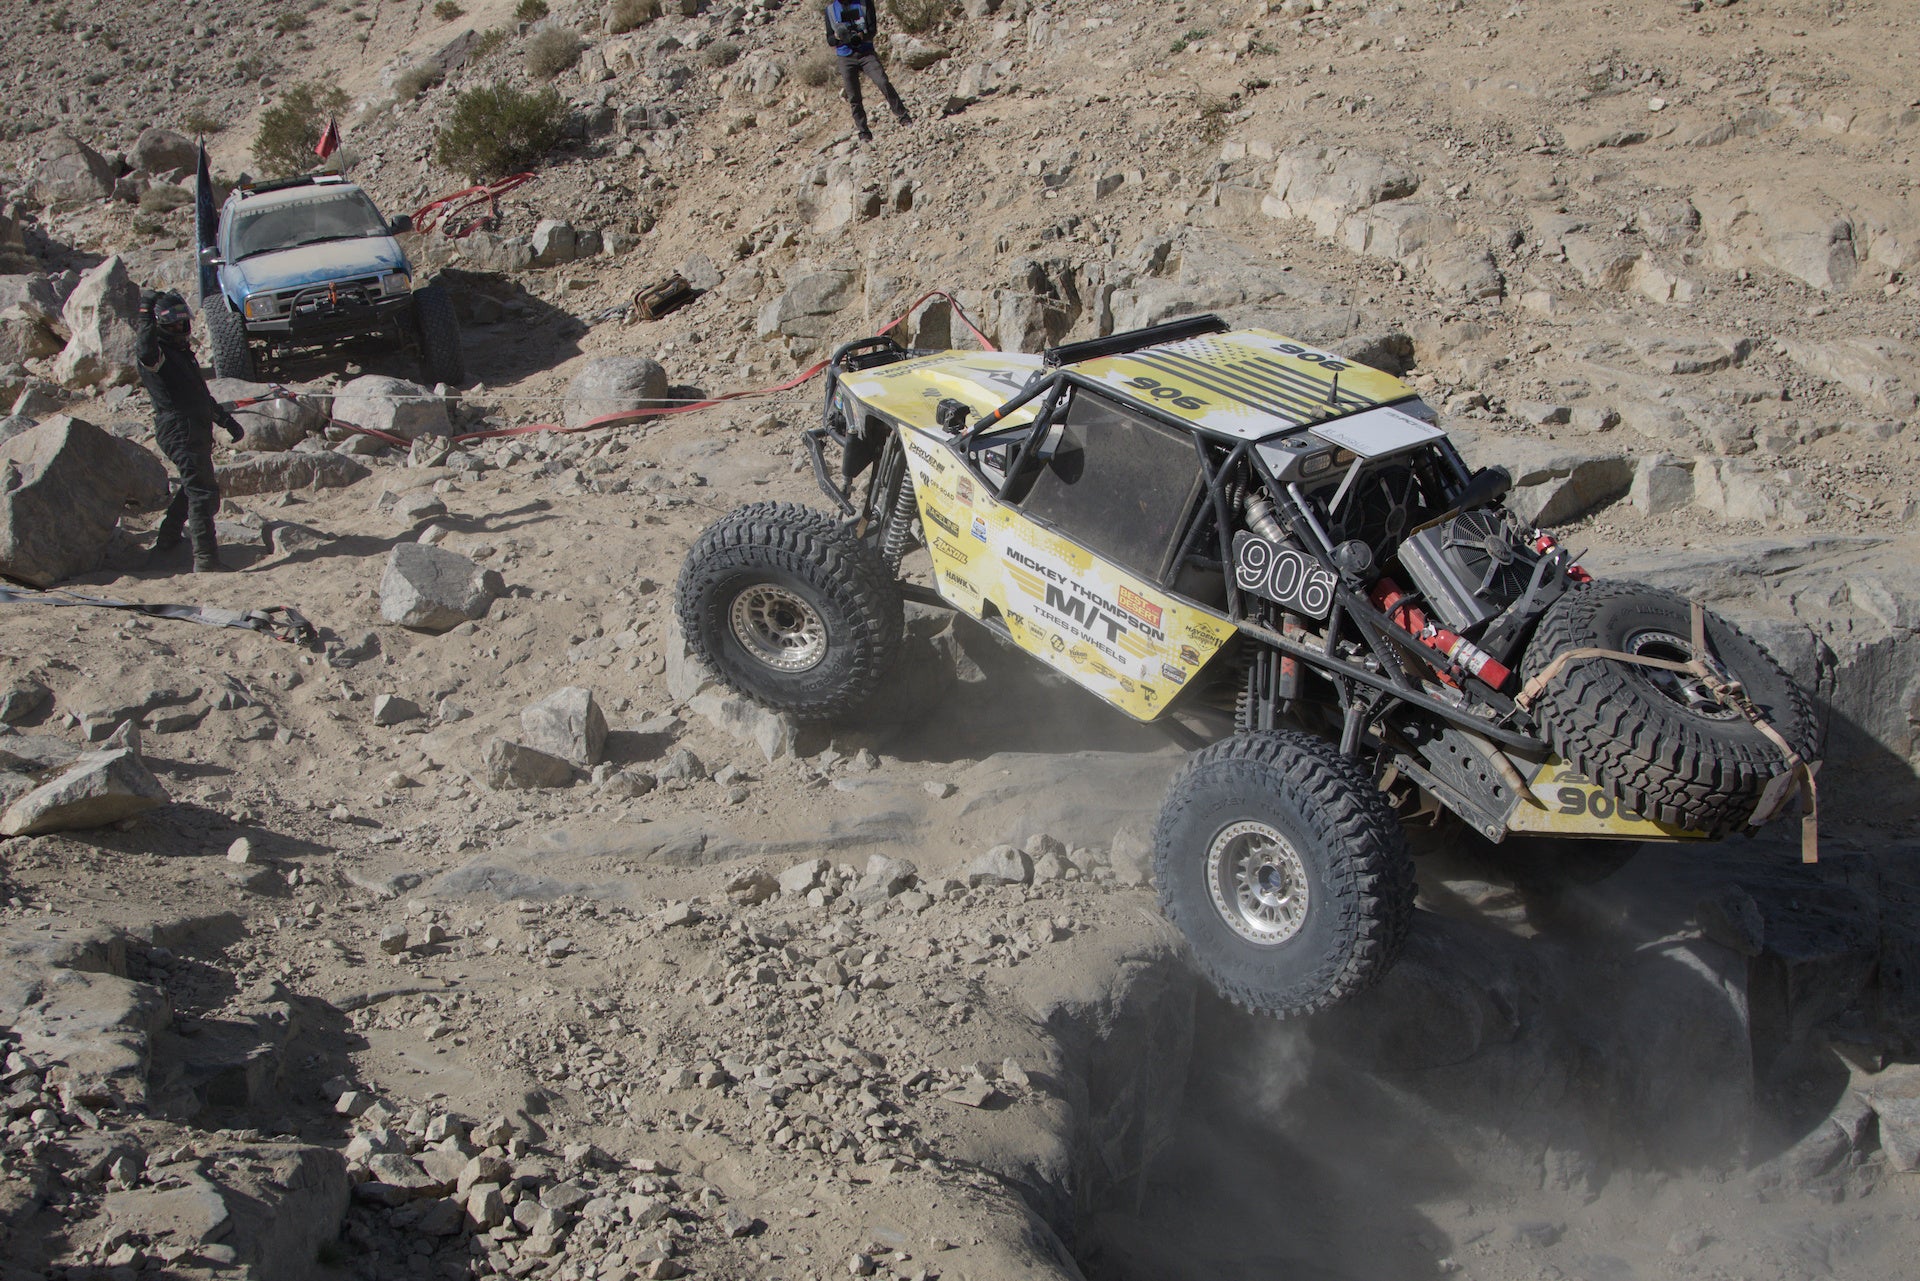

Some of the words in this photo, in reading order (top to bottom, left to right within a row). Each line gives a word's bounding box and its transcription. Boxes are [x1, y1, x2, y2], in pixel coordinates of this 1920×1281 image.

[1272, 343, 1353, 372] 906
[1124, 376, 1211, 410] 906
[933, 536, 968, 565] AMSOIL
[946, 569, 968, 589] HAWK
[1236, 538, 1335, 615] 906
[1006, 546, 1068, 585] MICKEY
[1070, 580, 1165, 642] THOMPSON
[1120, 586, 1149, 608] BEST
[1046, 583, 1127, 644] M/T
[1119, 597, 1160, 624] DESERT
[1033, 604, 1069, 630] TIRES
[1081, 631, 1127, 665] WHEELS
